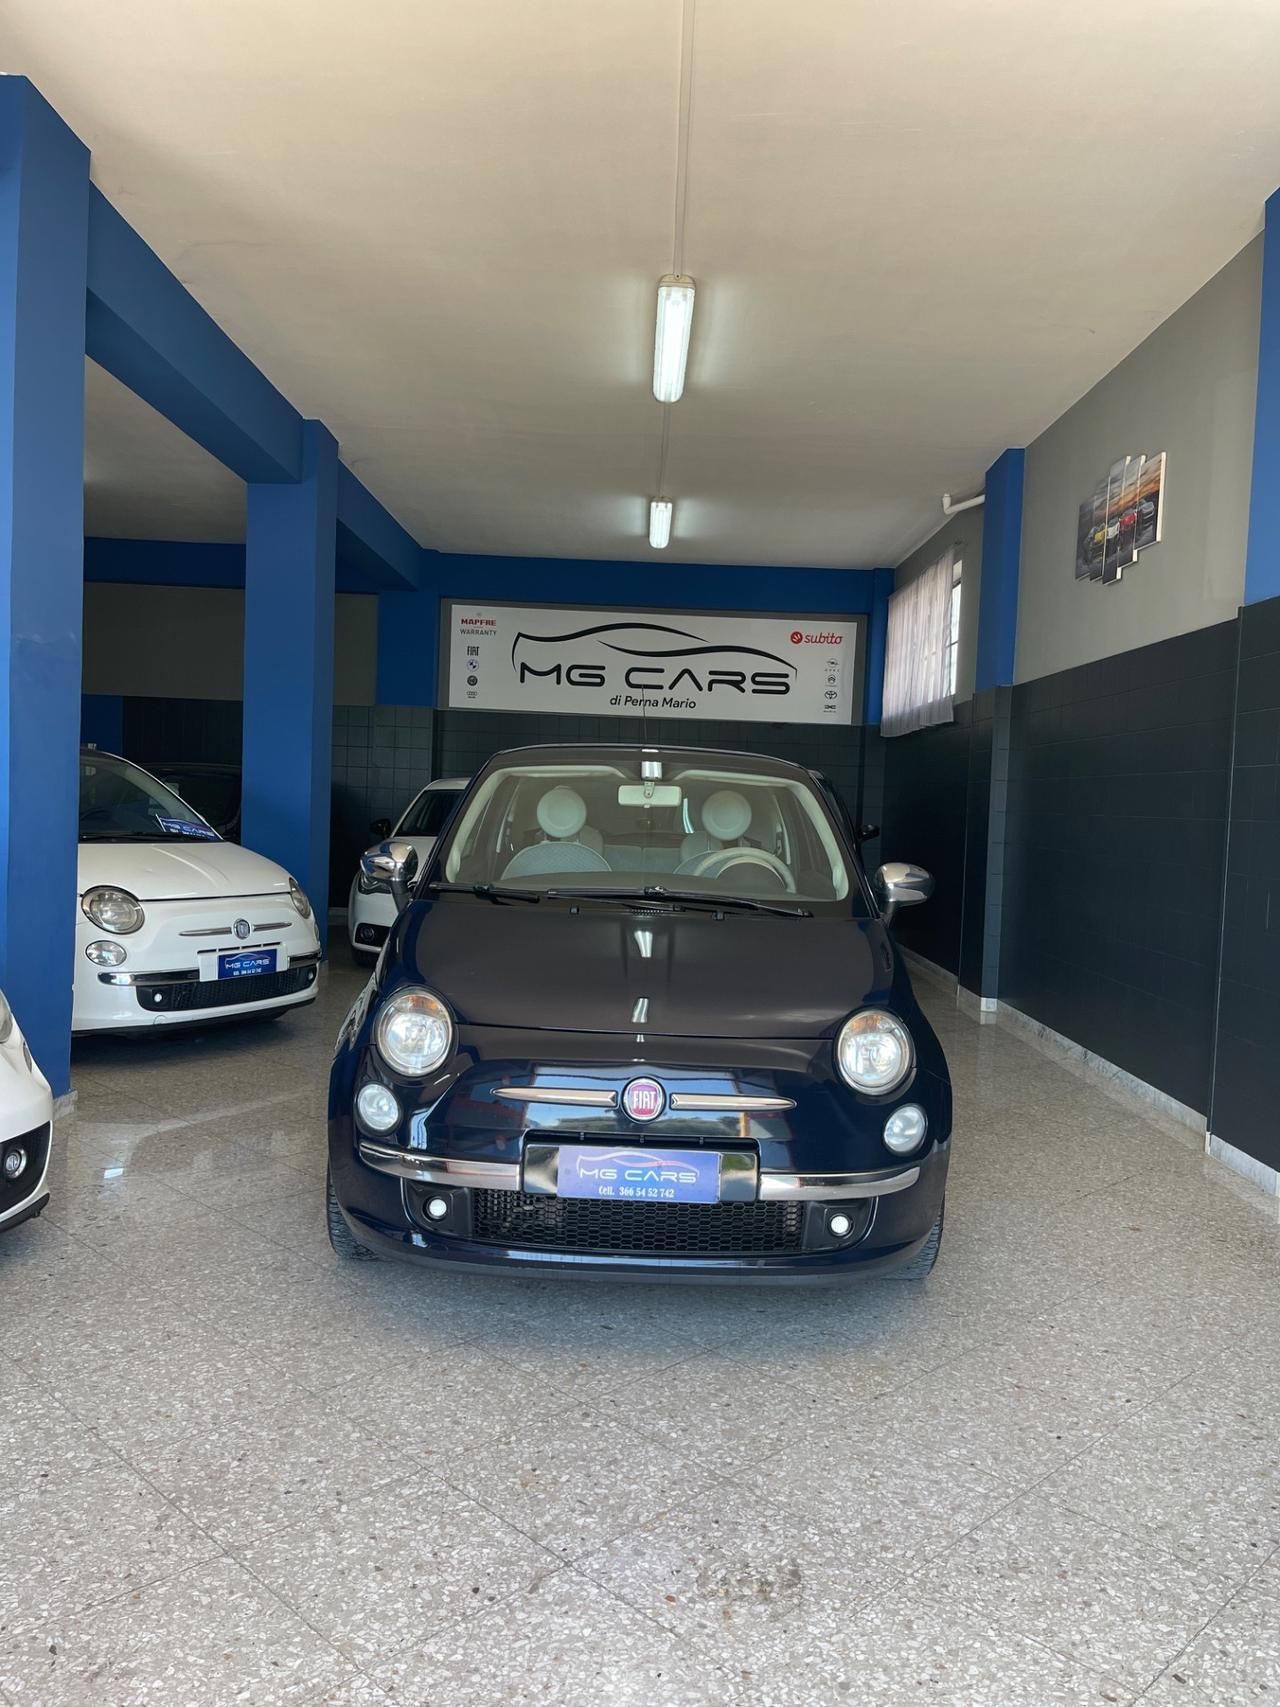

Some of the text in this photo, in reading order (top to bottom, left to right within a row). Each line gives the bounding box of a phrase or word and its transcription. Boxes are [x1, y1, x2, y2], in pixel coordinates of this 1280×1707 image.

[460, 618, 497, 627] MAPFRE
[459, 629, 497, 637] WARRANTY
[804, 632, 843, 645] subito
[519, 661, 790, 695] MG CARS
[609, 694, 697, 709] di Perna Mario
[242, 959, 270, 967] CARS
[633, 1091, 657, 1110] FIAT
[579, 1168, 697, 1184] MG CARS
[619, 1186, 634, 1197] 366
[635, 1187, 646, 1197] 54
[647, 1187, 658, 1198] 52
[659, 1188, 675, 1198] 742
